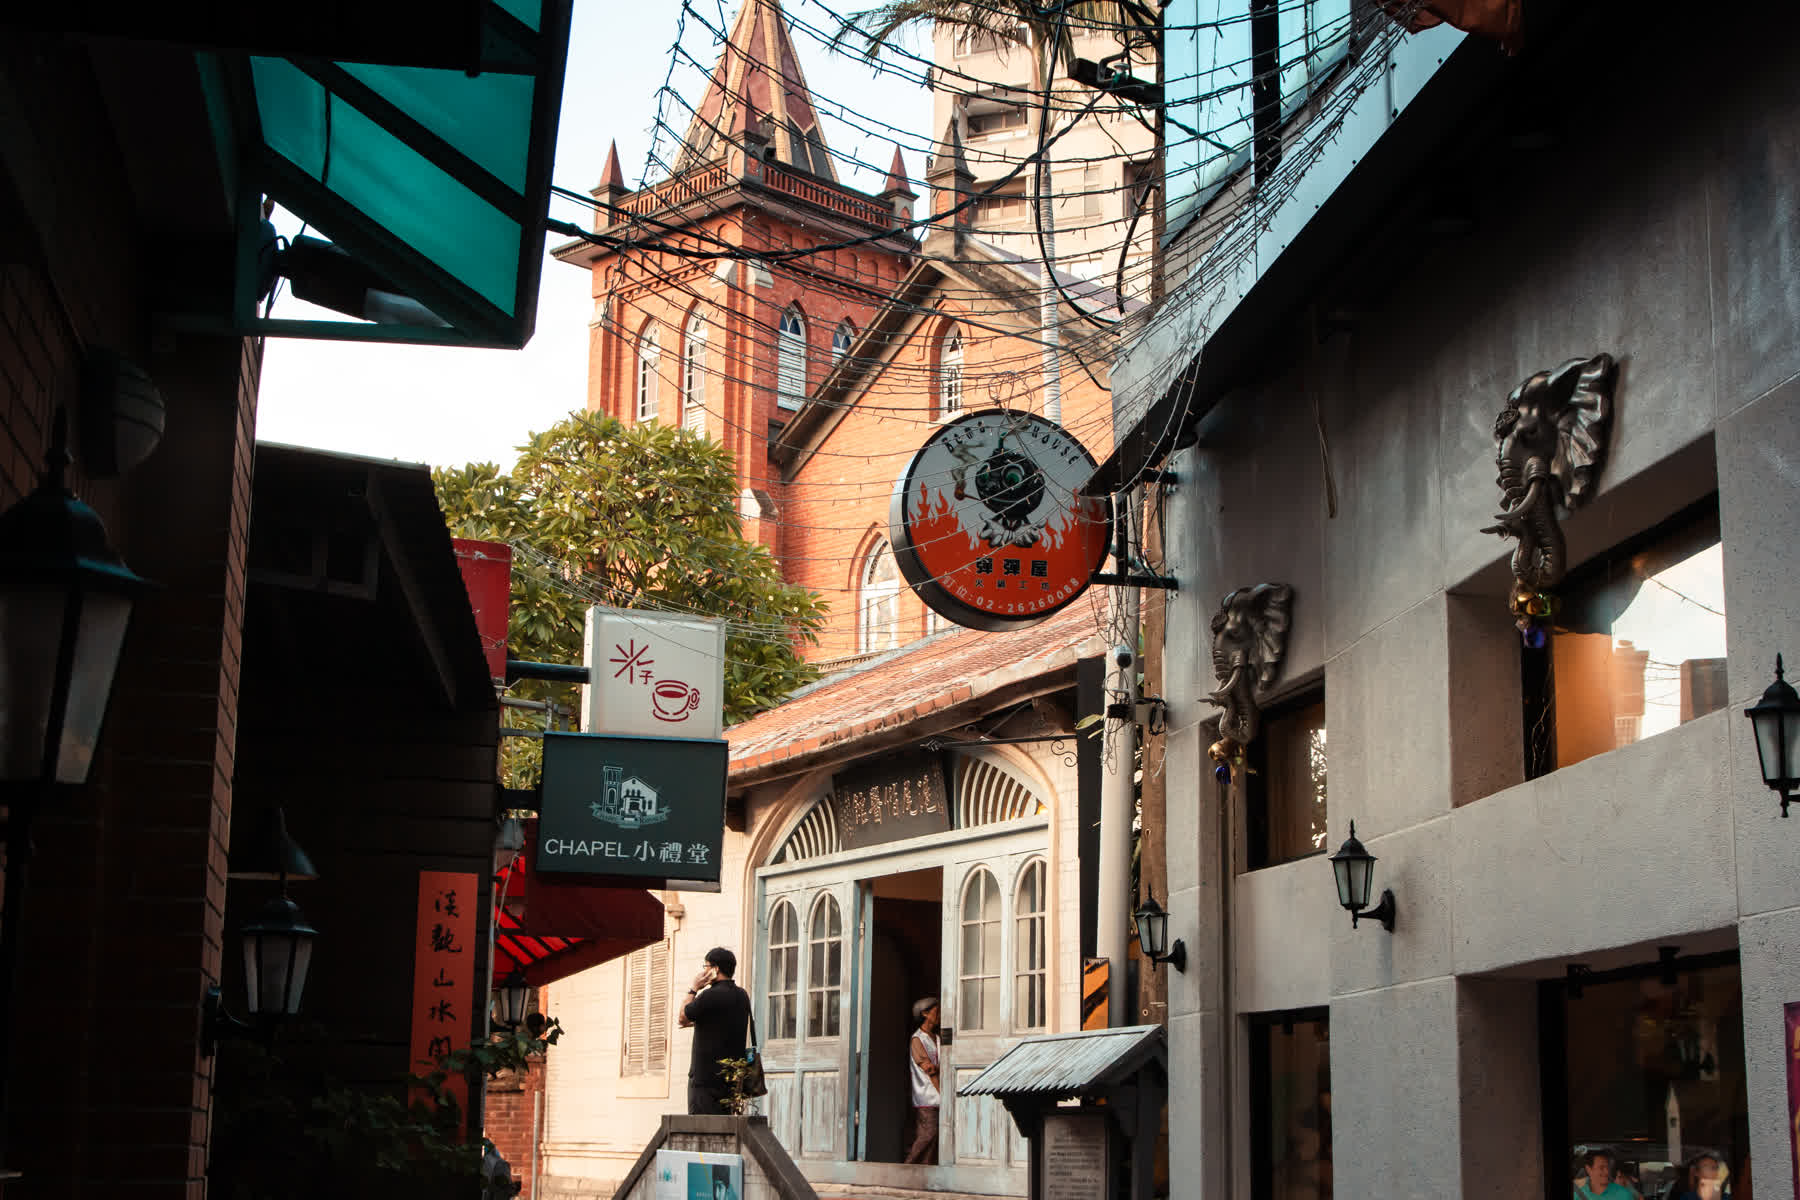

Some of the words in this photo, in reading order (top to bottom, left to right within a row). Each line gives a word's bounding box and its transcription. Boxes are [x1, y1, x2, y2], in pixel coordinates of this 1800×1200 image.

[545, 838, 630, 858] CHAPEL
[633, 840, 711, 865] 小禮堂
